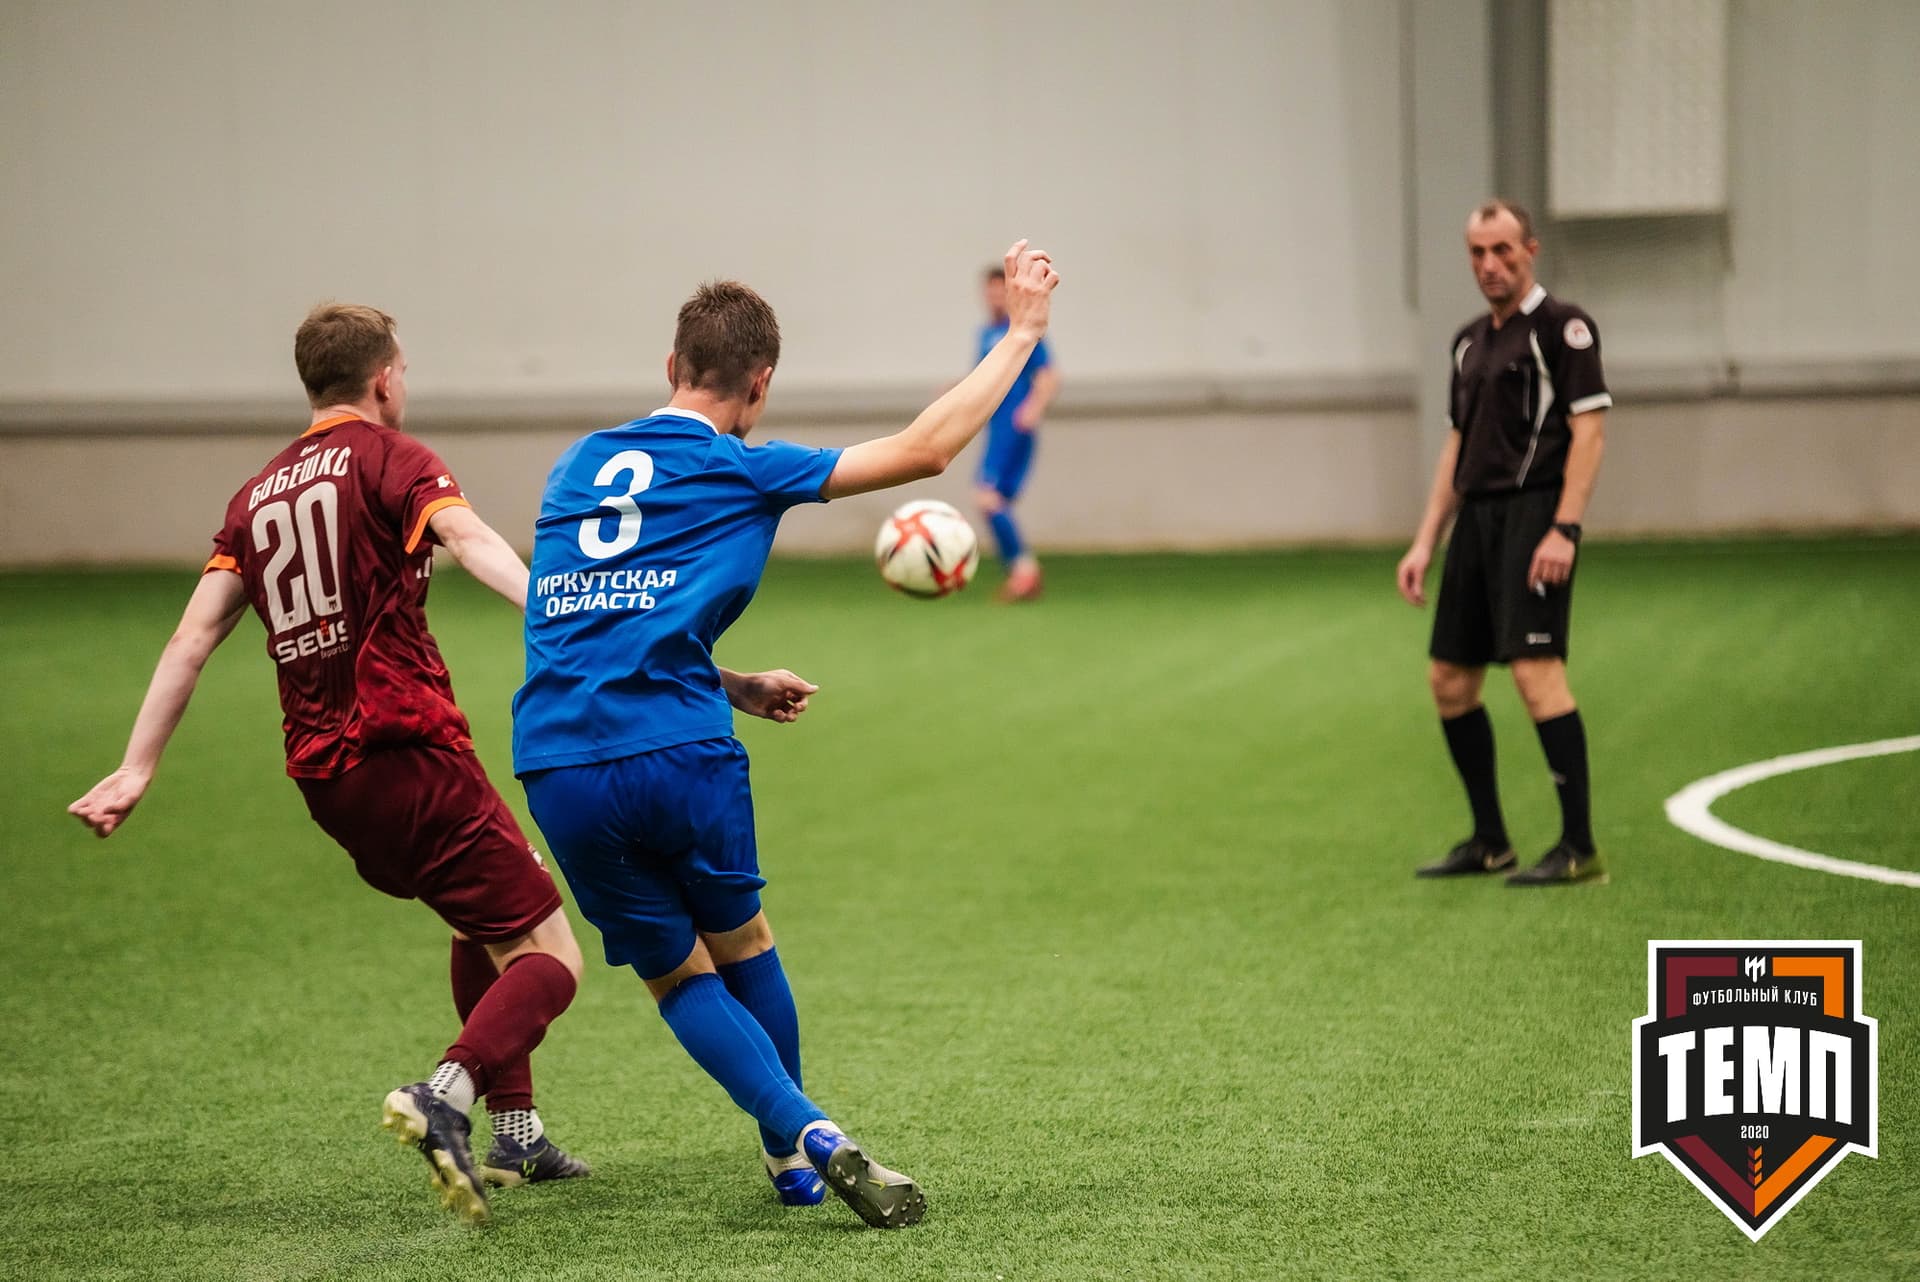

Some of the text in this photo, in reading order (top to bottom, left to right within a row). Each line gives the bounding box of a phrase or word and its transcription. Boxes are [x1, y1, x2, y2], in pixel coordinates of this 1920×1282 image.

[248, 446, 352, 512] БОБЕШКО
[578, 449, 654, 560] 3
[251, 481, 343, 635] 20
[536, 569, 677, 597] ИРКУТСКАЯ
[545, 591, 656, 617] ОБЛАСТЬ
